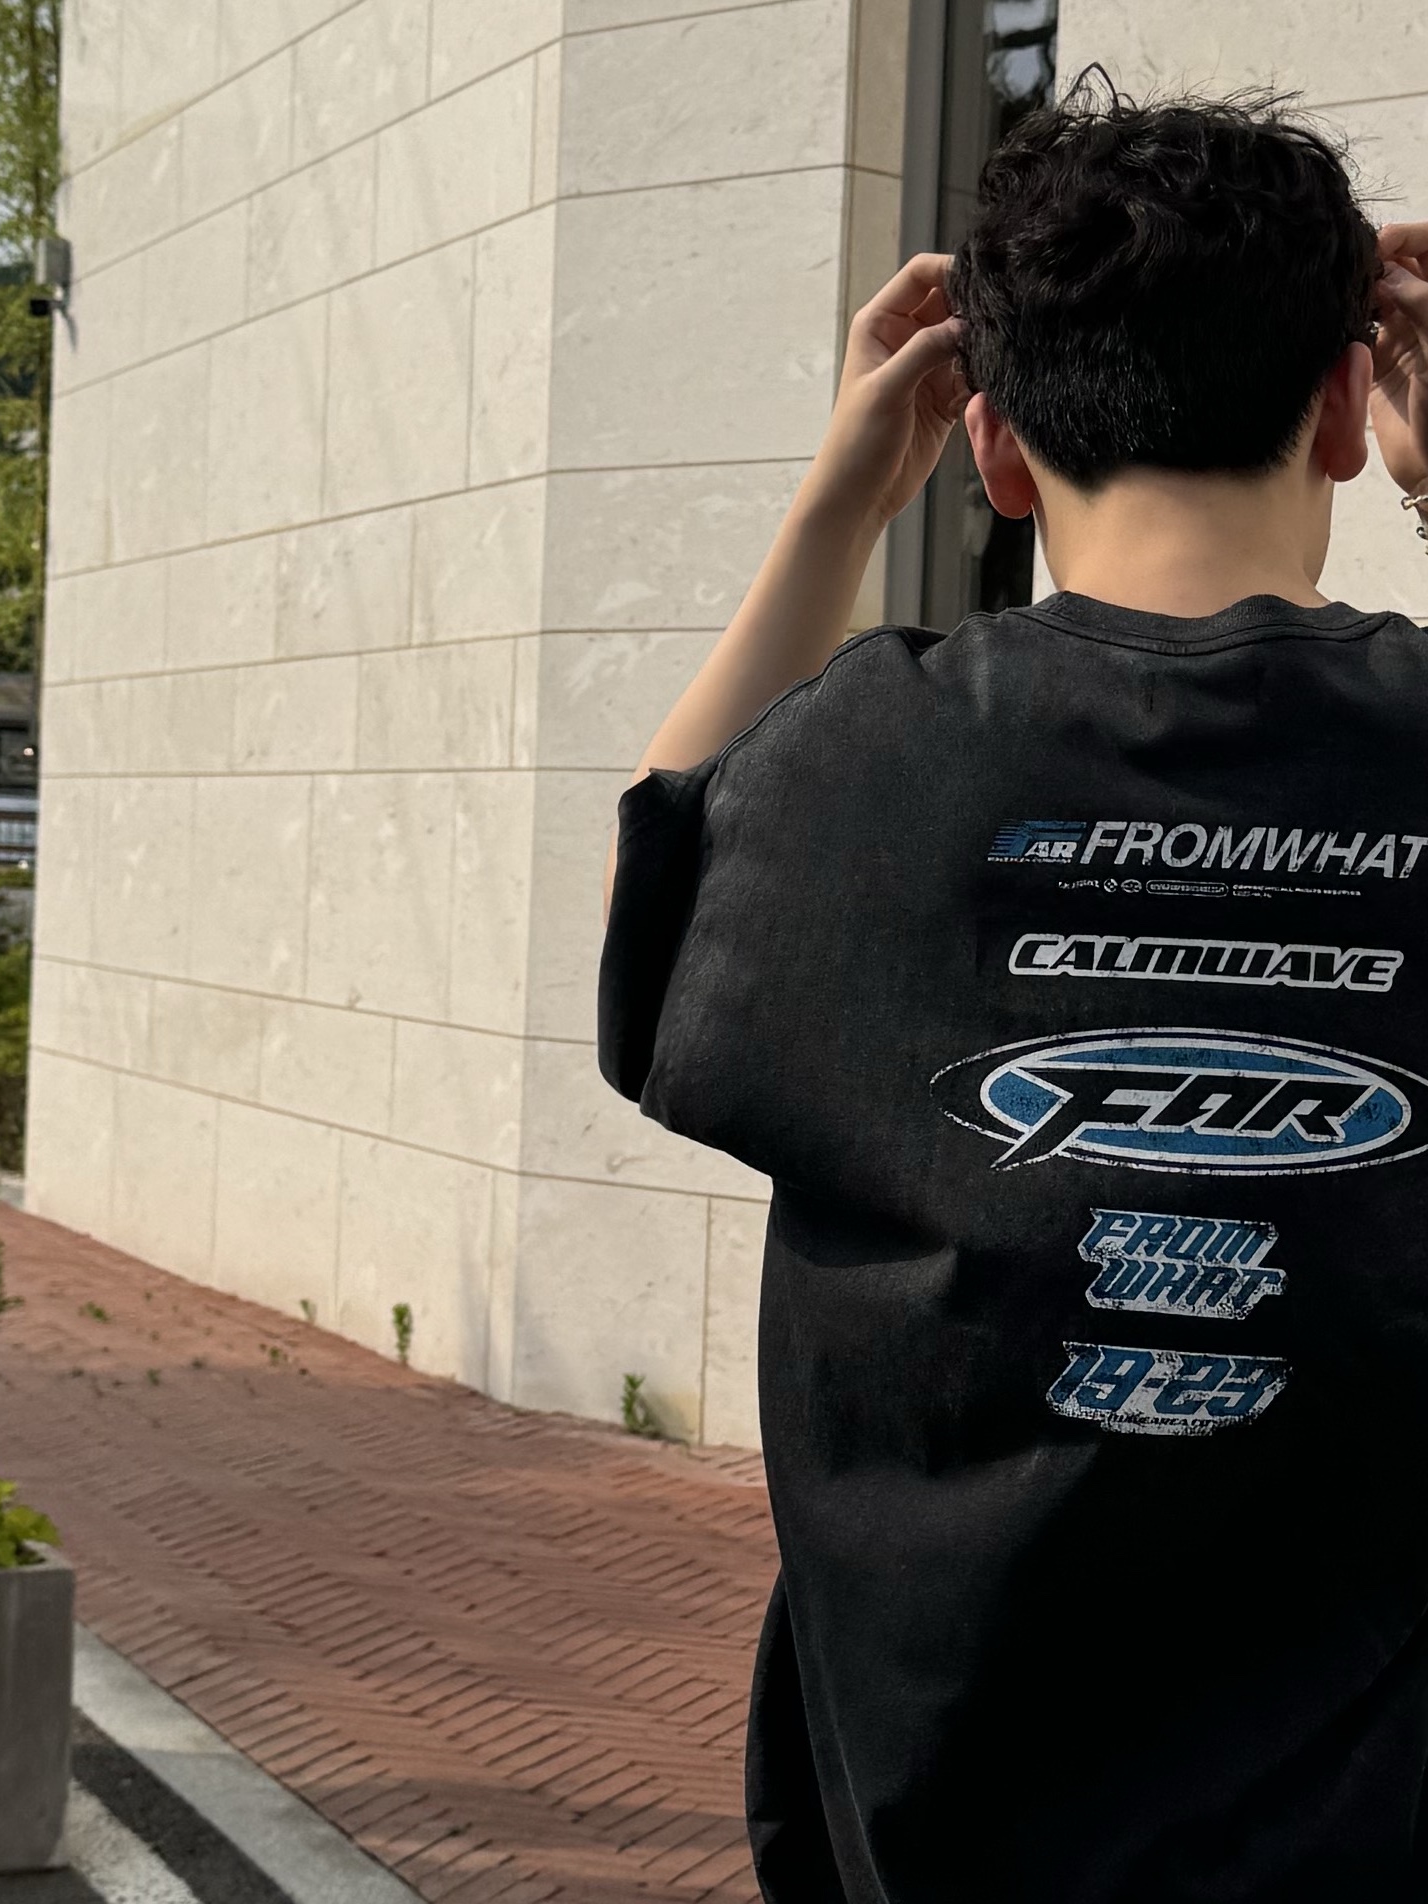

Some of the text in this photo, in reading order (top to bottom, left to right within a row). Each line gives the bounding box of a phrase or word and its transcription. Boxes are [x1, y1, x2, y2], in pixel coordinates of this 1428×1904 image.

[1010, 934, 1404, 991] CALMWAVE
[1079, 1208, 1277, 1265] FROM
[1087, 1260, 1285, 1317] WHAT
[1047, 1342, 1287, 1419] 19-23
